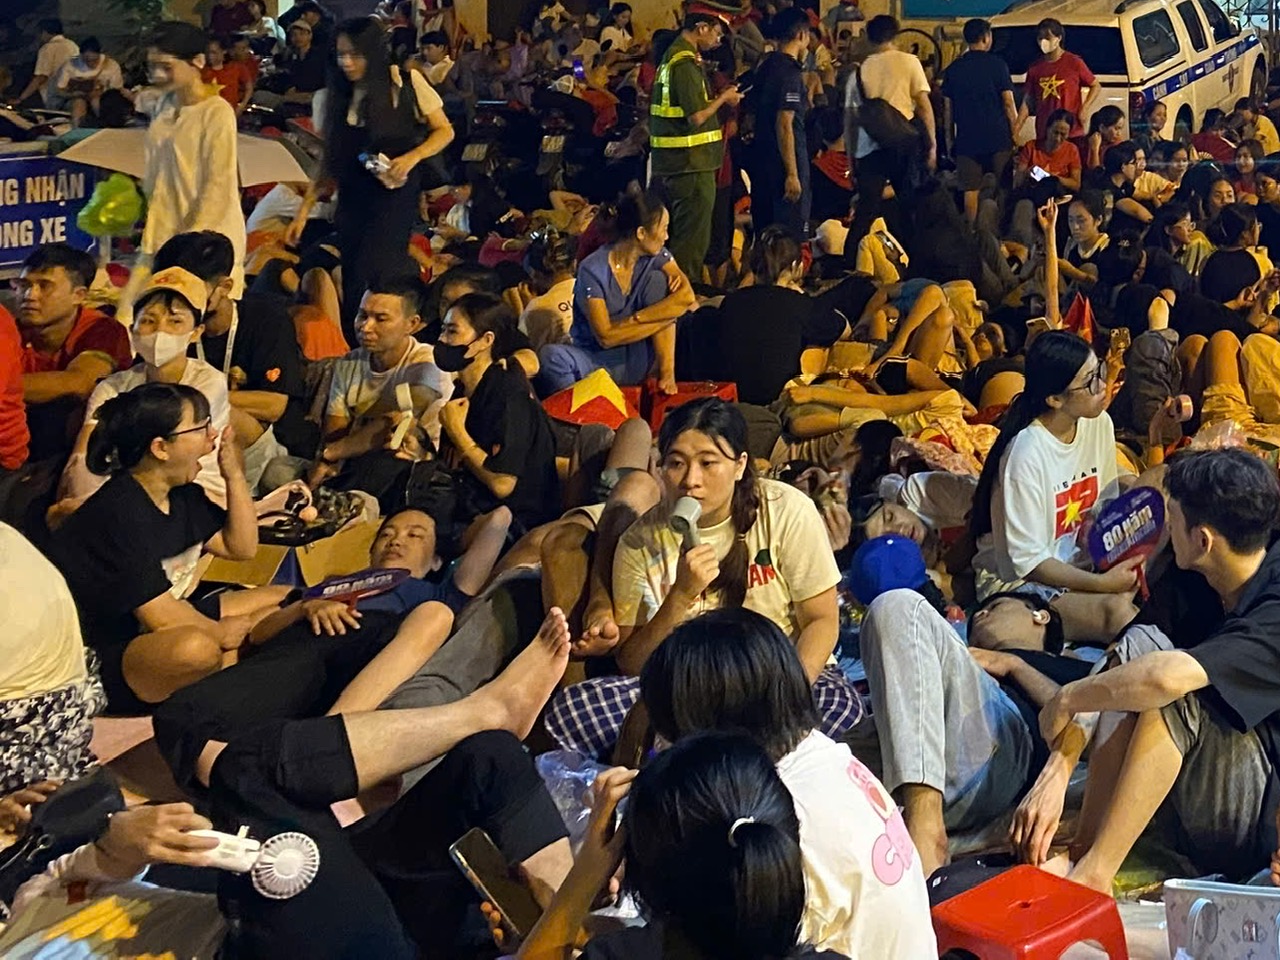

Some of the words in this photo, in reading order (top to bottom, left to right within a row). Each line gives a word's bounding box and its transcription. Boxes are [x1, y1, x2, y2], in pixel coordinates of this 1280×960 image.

[25, 168, 85, 206] NHẬN
[40, 216, 67, 244] XE
[1103, 524, 1123, 552] 80
